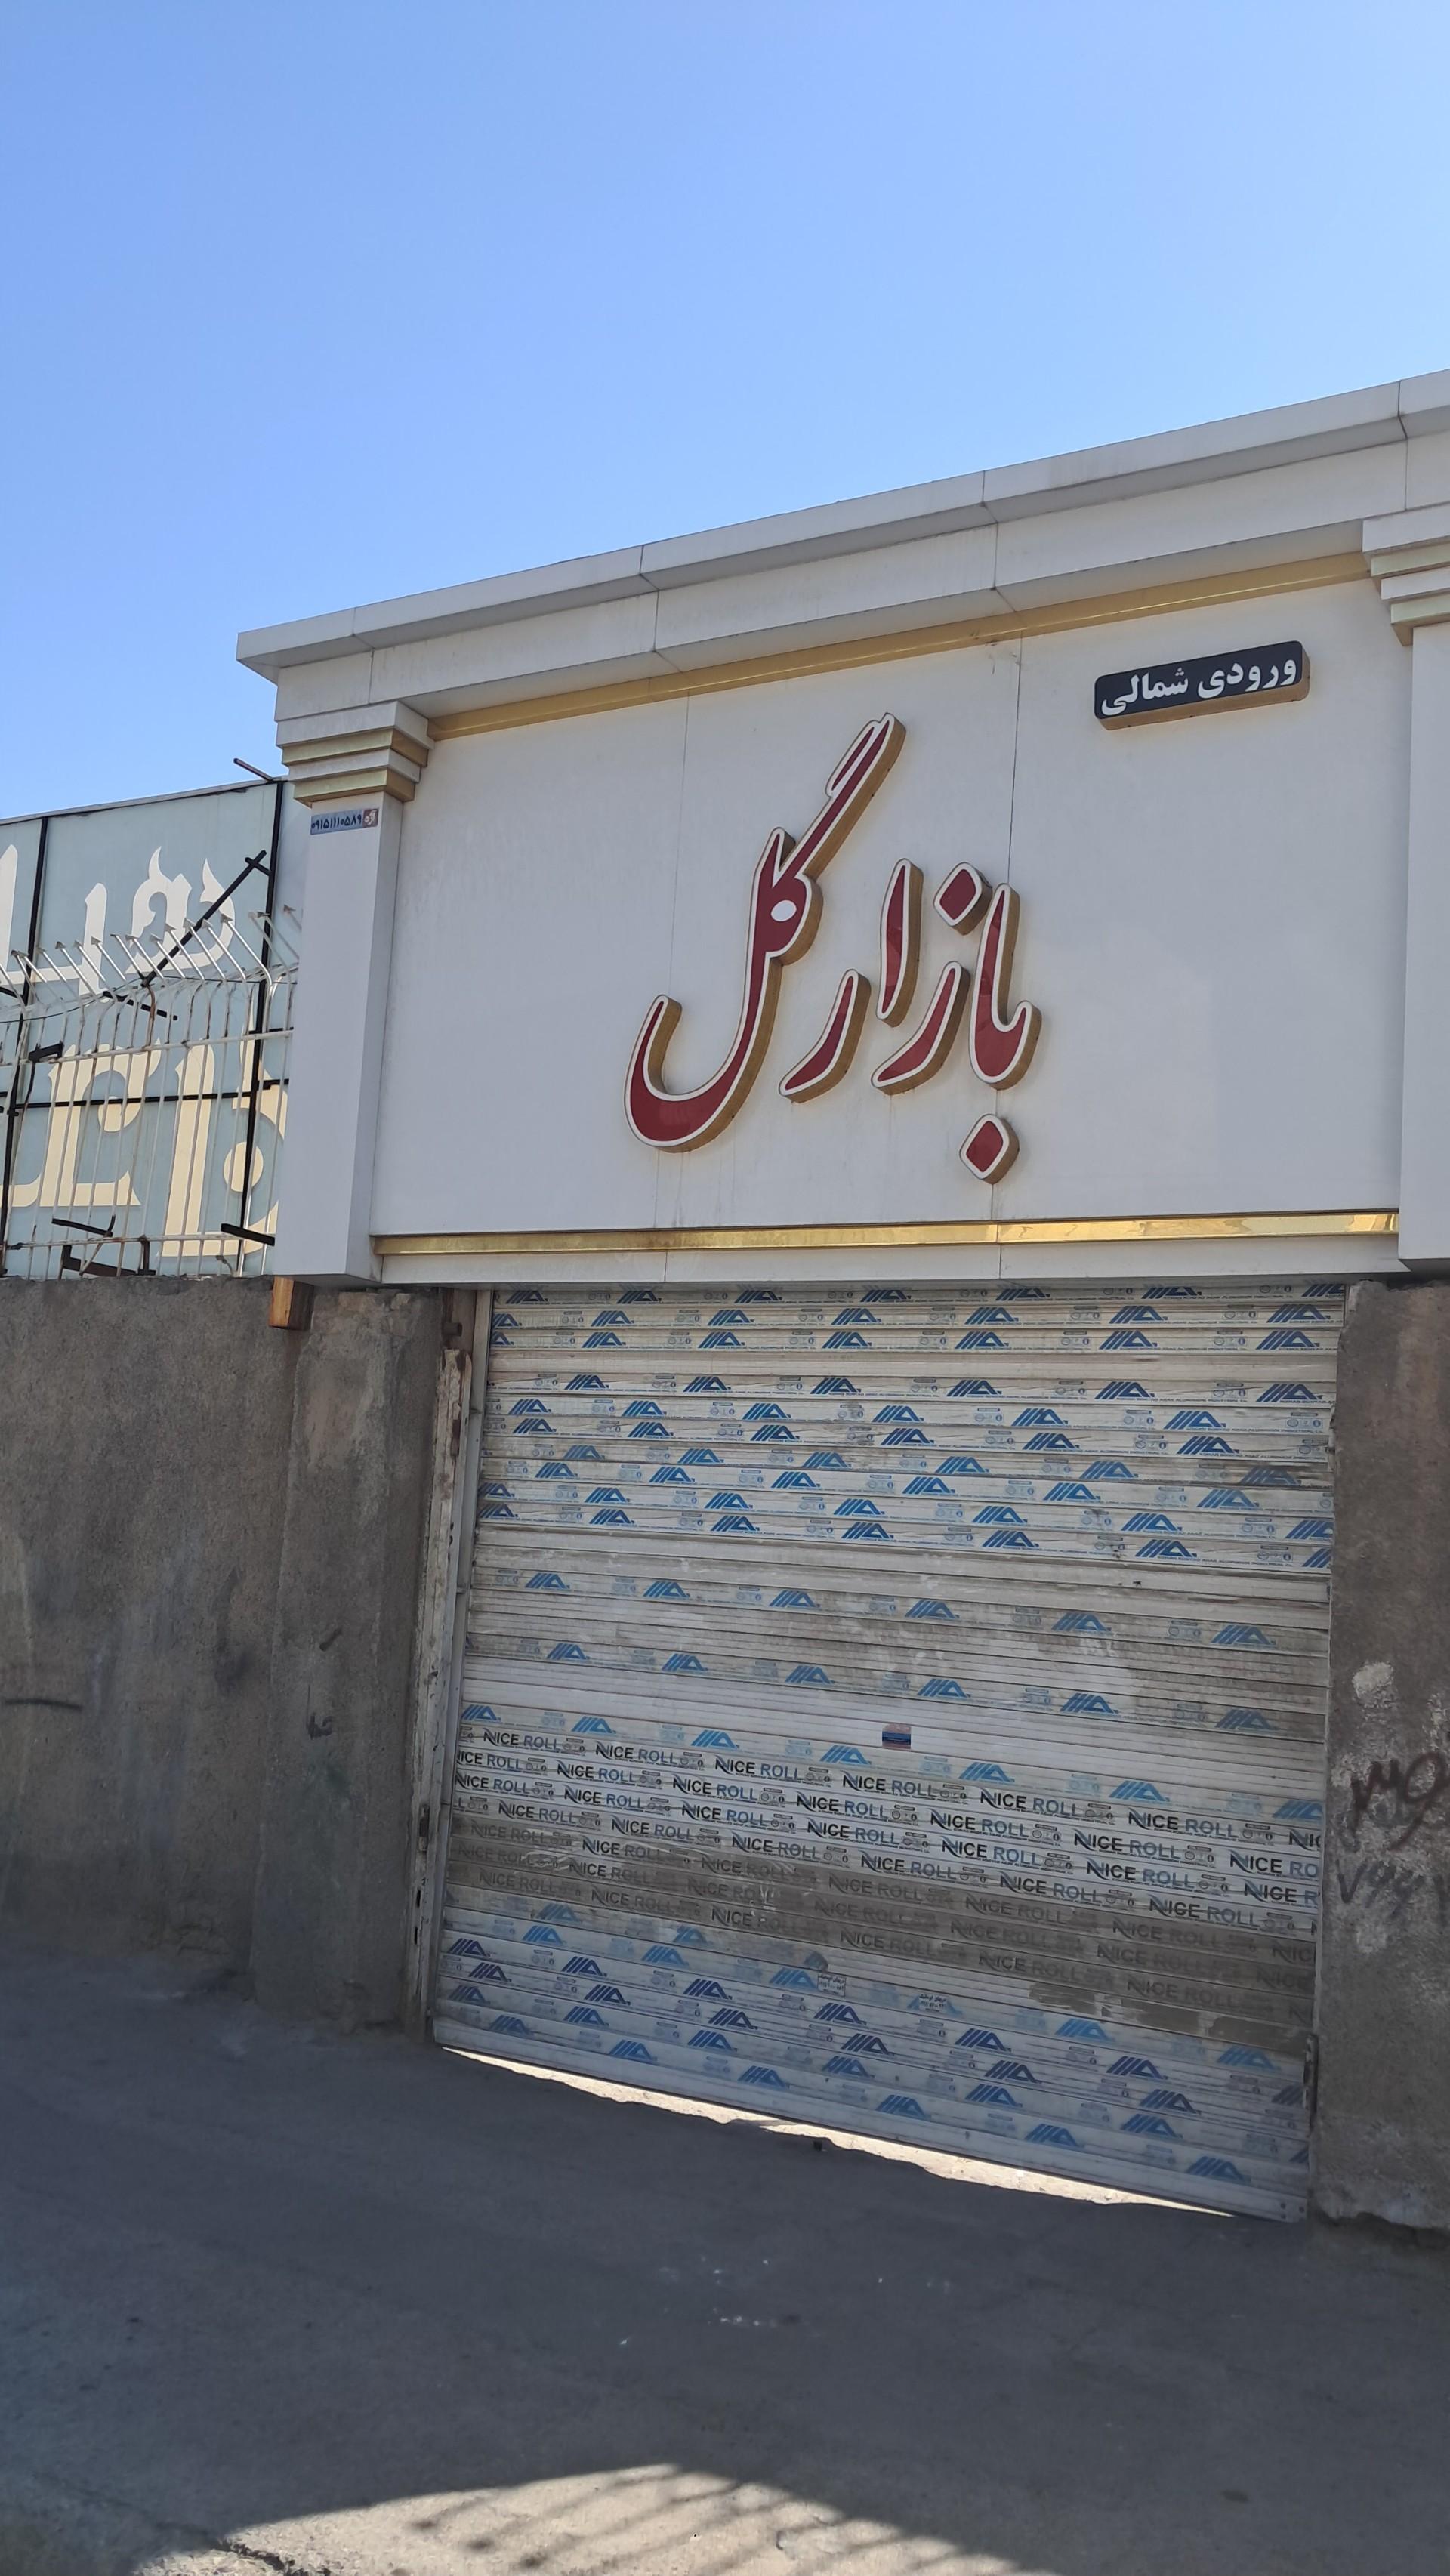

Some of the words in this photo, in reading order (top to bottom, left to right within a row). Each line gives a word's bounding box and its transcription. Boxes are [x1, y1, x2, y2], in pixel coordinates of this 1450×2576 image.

[1100, 666, 1189, 716] شمالی
[1198, 659, 1297, 699] ورودی
[625, 712, 901, 1150] گل
[779, 859, 1038, 1181] بازار
[455, 1771, 489, 1789] NICE
[493, 1779, 530, 1794] ROLL
[564, 1784, 602, 1804] NICE
[606, 1793, 644, 1809] ROLL
[681, 1800, 722, 1820] NICE
[726, 1809, 769, 1827] ROLL
[807, 1817, 850, 1838] NICE
[855, 1827, 901, 1846] ROLL
[942, 1836, 988, 1858] NICE
[993, 1846, 1041, 1866] ROLL
[1086, 1857, 1136, 1881] NICE
[1142, 1868, 1195, 1888] ROLL
[1244, 1878, 1297, 1903] NICE
[483, 1728, 520, 1746] NICE
[523, 1735, 563, 1751] ROLL
[596, 1741, 634, 1760] NICE
[638, 1749, 678, 1765] ROLL
[715, 1754, 755, 1775] NICE
[760, 1763, 801, 1781] ROLL
[841, 1769, 886, 1791] NICE
[891, 1780, 936, 1797] ROLL
[979, 1787, 1026, 1809] NICE
[1033, 1797, 1081, 1817] ROLL
[1128, 1807, 1178, 1830] NICE
[1186, 1819, 1239, 1838] ROLL
[486, 1754, 523, 1770] ROLL
[556, 1760, 594, 1779] NICE
[598, 1767, 637, 1783] ROLL
[673, 1774, 711, 1794] NICE
[717, 1784, 757, 1800] ROLL
[796, 1791, 839, 1812] NICE
[844, 1800, 890, 1819] ROLL
[930, 1808, 976, 1830] NICE
[982, 1818, 1029, 1838] ROLL
[1073, 1828, 1123, 1851] NICE
[1129, 1839, 1181, 1859] ROLL
[1229, 1849, 1282, 1874] NICE
[1289, 1860, 1319, 1878] RO
[458, 1841, 492, 1861] NICE
[569, 1856, 606, 1877] NICE
[688, 1878, 728, 1897] NICE
[815, 1895, 858, 1917] NICE
[950, 1917, 997, 1940] NICE
[1097, 1941, 1147, 1964] NICE
[471, 1819, 505, 1838] NICE
[582, 1835, 620, 1856] NICE
[702, 1854, 742, 1874] NICE
[828, 1872, 872, 1894] NICE
[965, 1892, 1013, 1916] NICE
[1112, 1915, 1163, 1940] NICE
[1272, 1939, 1313, 1964] NIC
[498, 1799, 535, 1819] NICE
[538, 1808, 576, 1825] ROLL
[612, 1815, 650, 1835] NICE
[654, 1824, 696, 1840] ROLL
[732, 1831, 773, 1853] NICE
[779, 1840, 819, 1860] ROLL
[861, 1850, 905, 1873] NICE
[910, 1861, 957, 1880] ROLL
[999, 1870, 1047, 1894] NICE
[1053, 1883, 1103, 1904] ROLL
[1148, 1894, 1200, 1918] NICE
[1207, 1906, 1260, 1928] ROLL
[479, 1867, 514, 1887] NICE
[591, 1884, 629, 1905] NICE
[711, 1905, 751, 1927] NICE
[840, 1927, 885, 1948] NICE
[978, 1949, 1026, 1972] NICE
[1127, 1974, 1177, 1998] NICE
